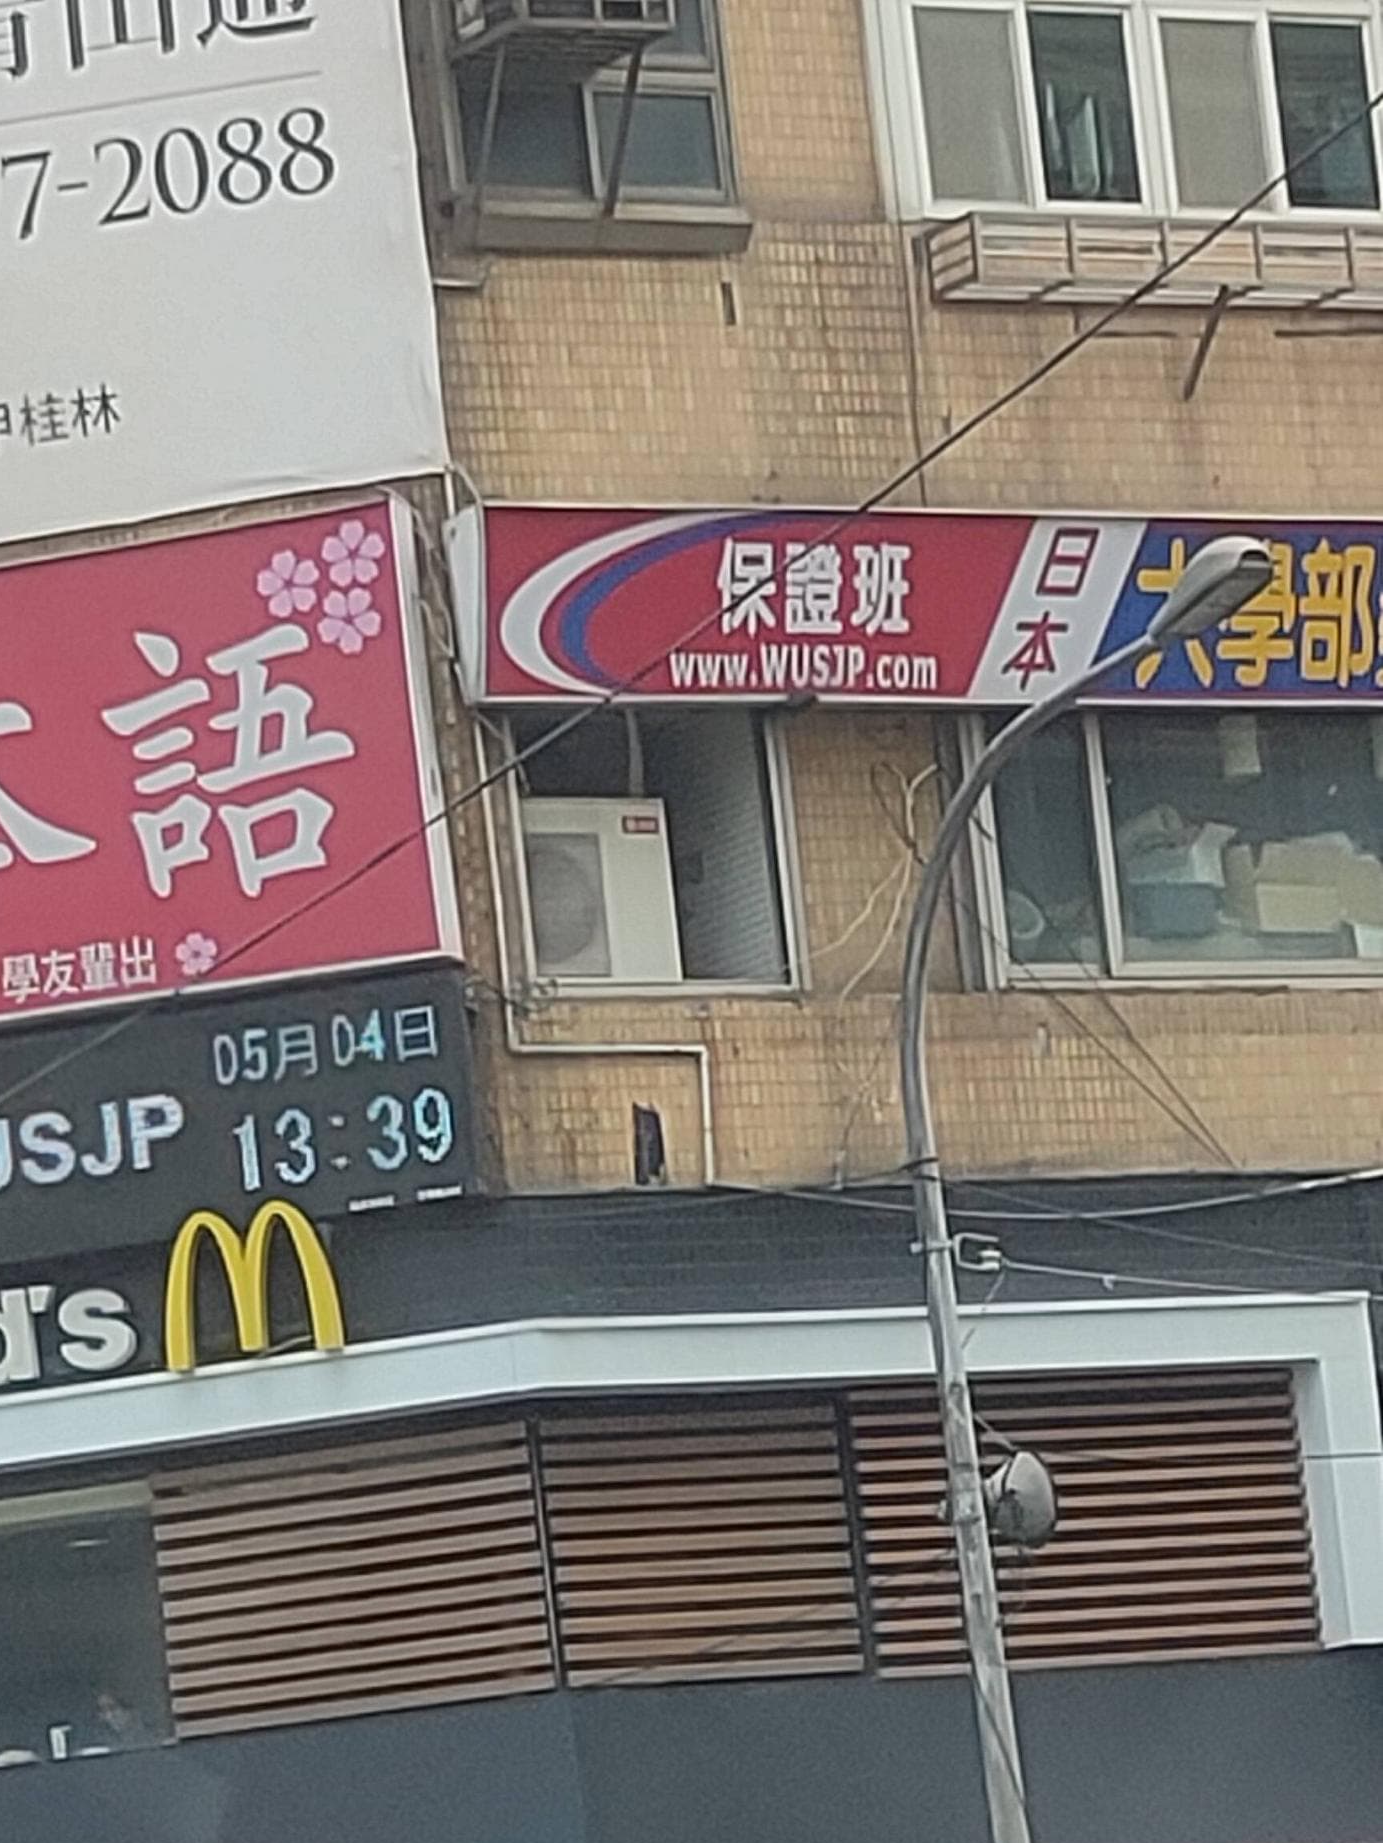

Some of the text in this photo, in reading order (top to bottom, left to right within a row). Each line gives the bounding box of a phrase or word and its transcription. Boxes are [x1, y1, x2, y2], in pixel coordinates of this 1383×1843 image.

[716, 536, 913, 637] 保證班
[1000, 526, 1100, 691] 日本
[669, 642, 938, 690] www.WUSJP.com
[1, 935, 158, 1005] 學友輩出
[232, 1086, 455, 1192] 13:39
